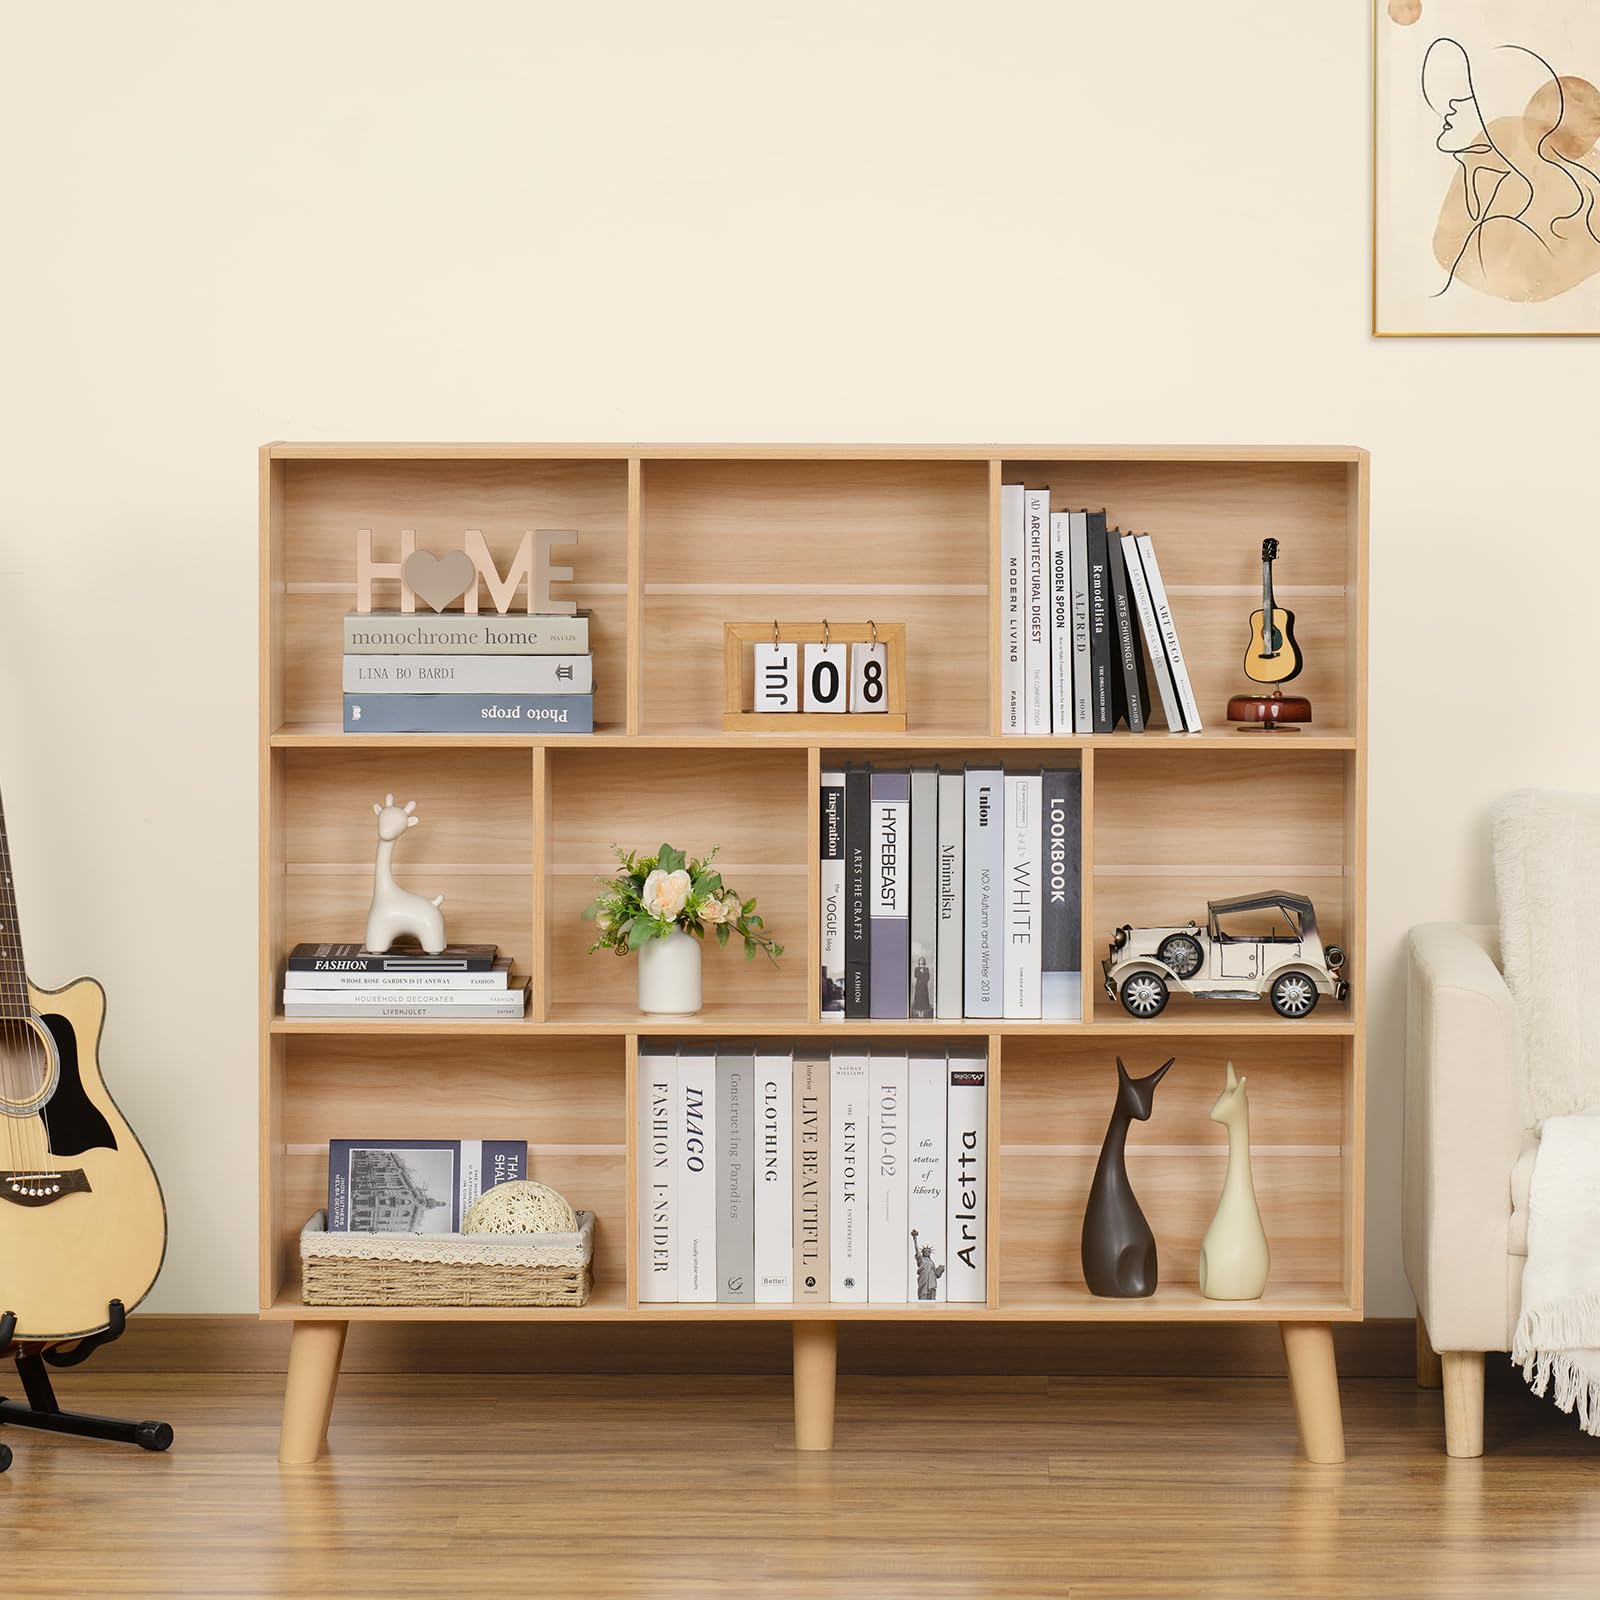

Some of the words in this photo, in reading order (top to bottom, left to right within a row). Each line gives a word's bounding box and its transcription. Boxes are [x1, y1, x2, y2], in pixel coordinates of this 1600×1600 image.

[1030, 498, 1041, 510] AD
[1031, 515, 1042, 602] ARCHITECTURAL
[1055, 550, 1064, 592] WOODEN
[1056, 595, 1065, 628] SPOON
[1093, 564, 1103, 634] Remodelista
[1118, 594, 1130, 618] ARTS
[1132, 568, 1147, 606] LEARNING
[1142, 607, 1152, 627] FROM
[352, 628, 479, 644] monochrome
[484, 628, 538, 644] home
[1032, 605, 1042, 644] DIGEST
[1075, 590, 1086, 653] ALPRED
[1158, 604, 1171, 626] ART
[1166, 631, 1180, 664] DECO
[1121, 620, 1134, 671] CHIWINGLO
[358, 668, 389, 680] LINA
[396, 668, 412, 680] BO
[418, 668, 456, 680] BARDI
[766, 656, 788, 705] JUL
[481, 706, 520, 718] props
[526, 709, 568, 723] Photo
[1130, 694, 1139, 724] FASHION
[825, 792, 840, 856] inspiration
[979, 786, 991, 827] Union
[854, 848, 862, 874] ARTS
[881, 808, 896, 910] HYPEBEAST
[1050, 798, 1065, 903] LOOKBOOK
[854, 877, 862, 897] THE
[942, 844, 955, 920] Minimalista
[982, 868, 990, 892] NO.9
[826, 896, 837, 936] VOGUE
[854, 900, 862, 940] CRAFTS
[982, 894, 990, 929] Autumn
[1013, 861, 1031, 944] WHITE
[982, 930, 990, 949] and
[314, 960, 368, 970] FASHION
[982, 950, 990, 976] Winter
[982, 978, 990, 1002] 2018
[806, 1064, 814, 1091] Interior
[652, 1083, 668, 1168] FASHION
[686, 1086, 704, 1173] IMAGO
[729, 1073, 742, 1157] Constructing
[764, 1081, 778, 1183] CLOTHING
[802, 1096, 818, 1144] LIVE
[880, 1084, 897, 1177] FOLIO-02
[844, 1122, 856, 1203] KINFOLK
[919, 1139, 933, 1148] the
[494, 1154, 505, 1186] SHAL
[507, 1155, 518, 1181] THA
[921, 1170, 933, 1182] of
[729, 1163, 742, 1219] Paradies
[802, 1149, 818, 1265] BEAUTIFUL
[912, 1186, 941, 1199] liberty
[955, 1130, 977, 1269] Arletta
